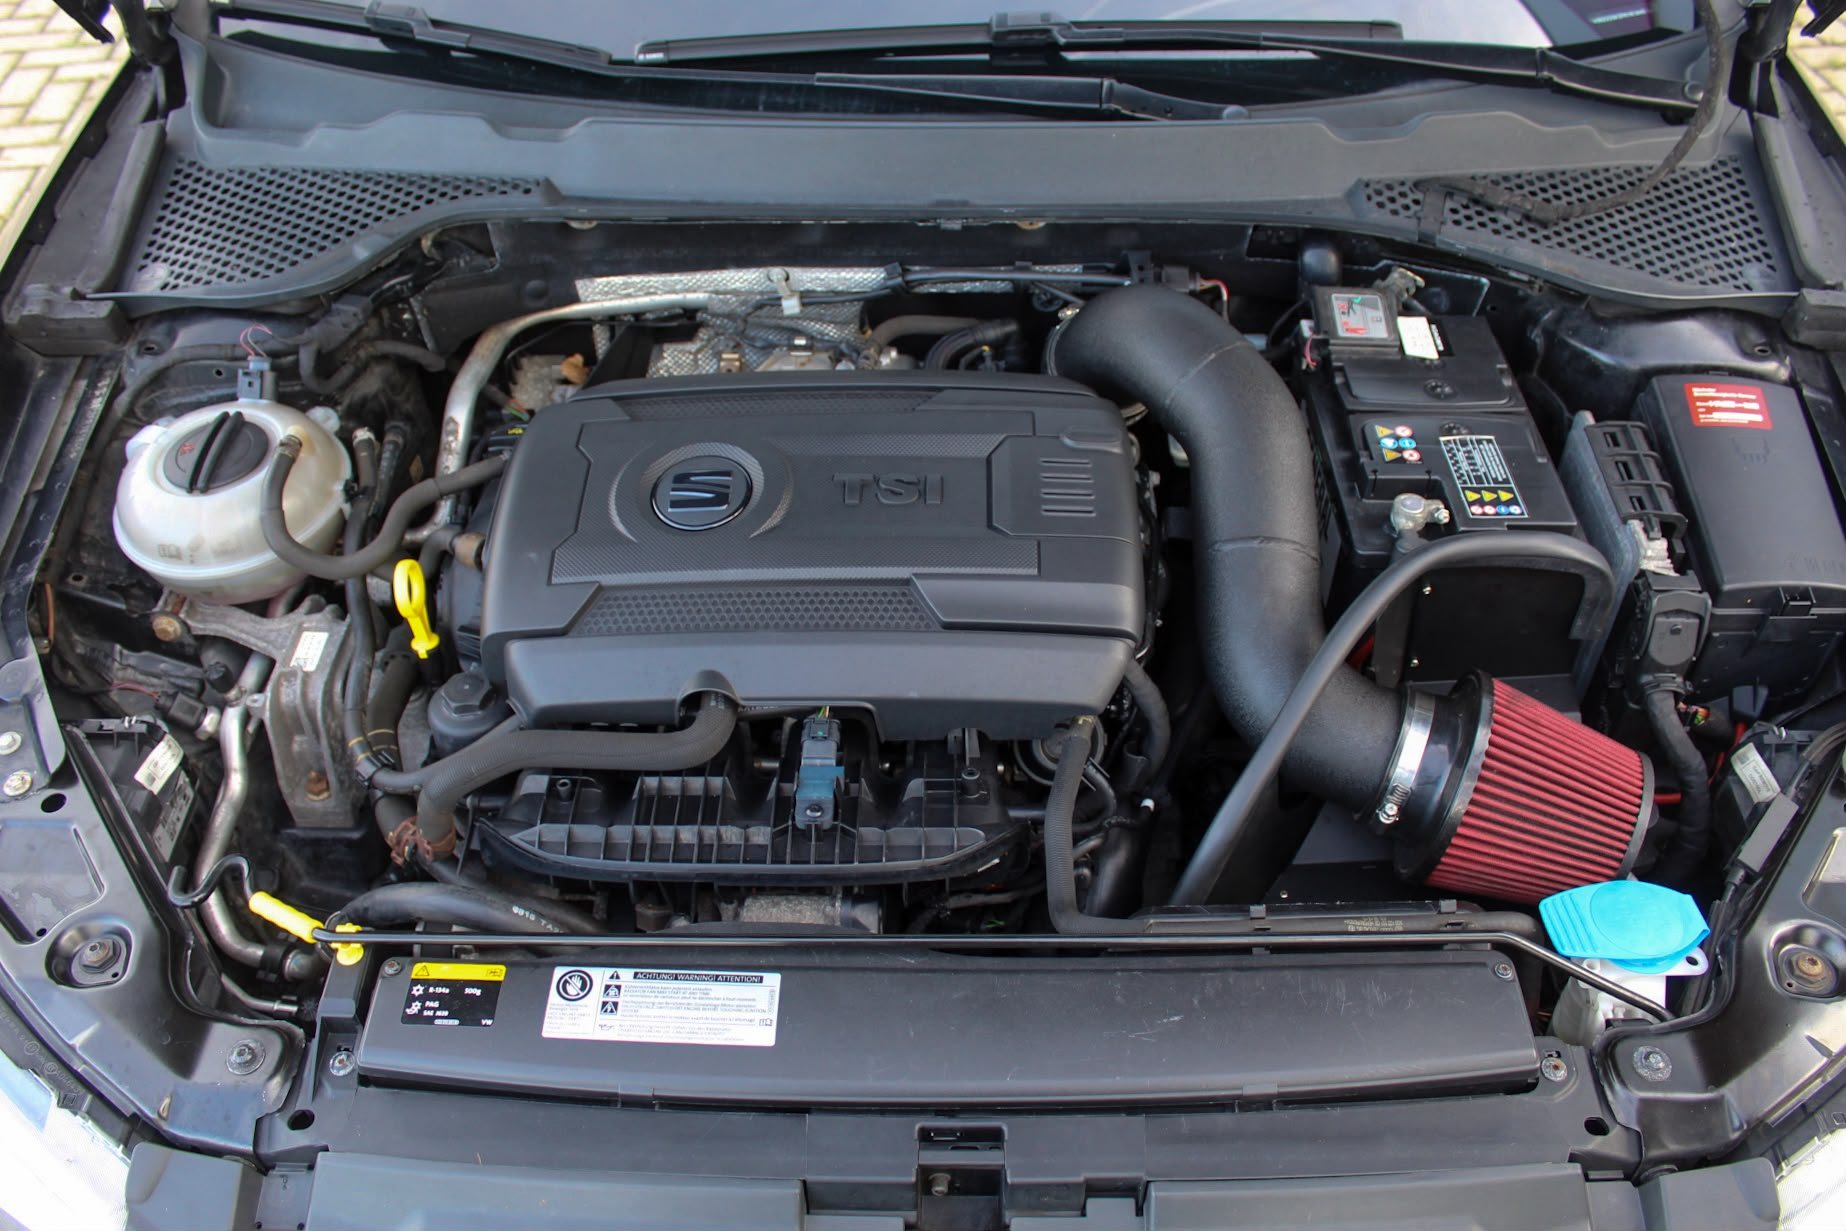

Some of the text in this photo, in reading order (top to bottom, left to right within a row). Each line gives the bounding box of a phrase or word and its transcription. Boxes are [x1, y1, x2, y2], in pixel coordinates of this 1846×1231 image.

[832, 473, 944, 505] TSI
[636, 972, 761, 983] ACHTUNG! WARNING! ATTENTION!
[428, 986, 481, 997] R-134a 500g
